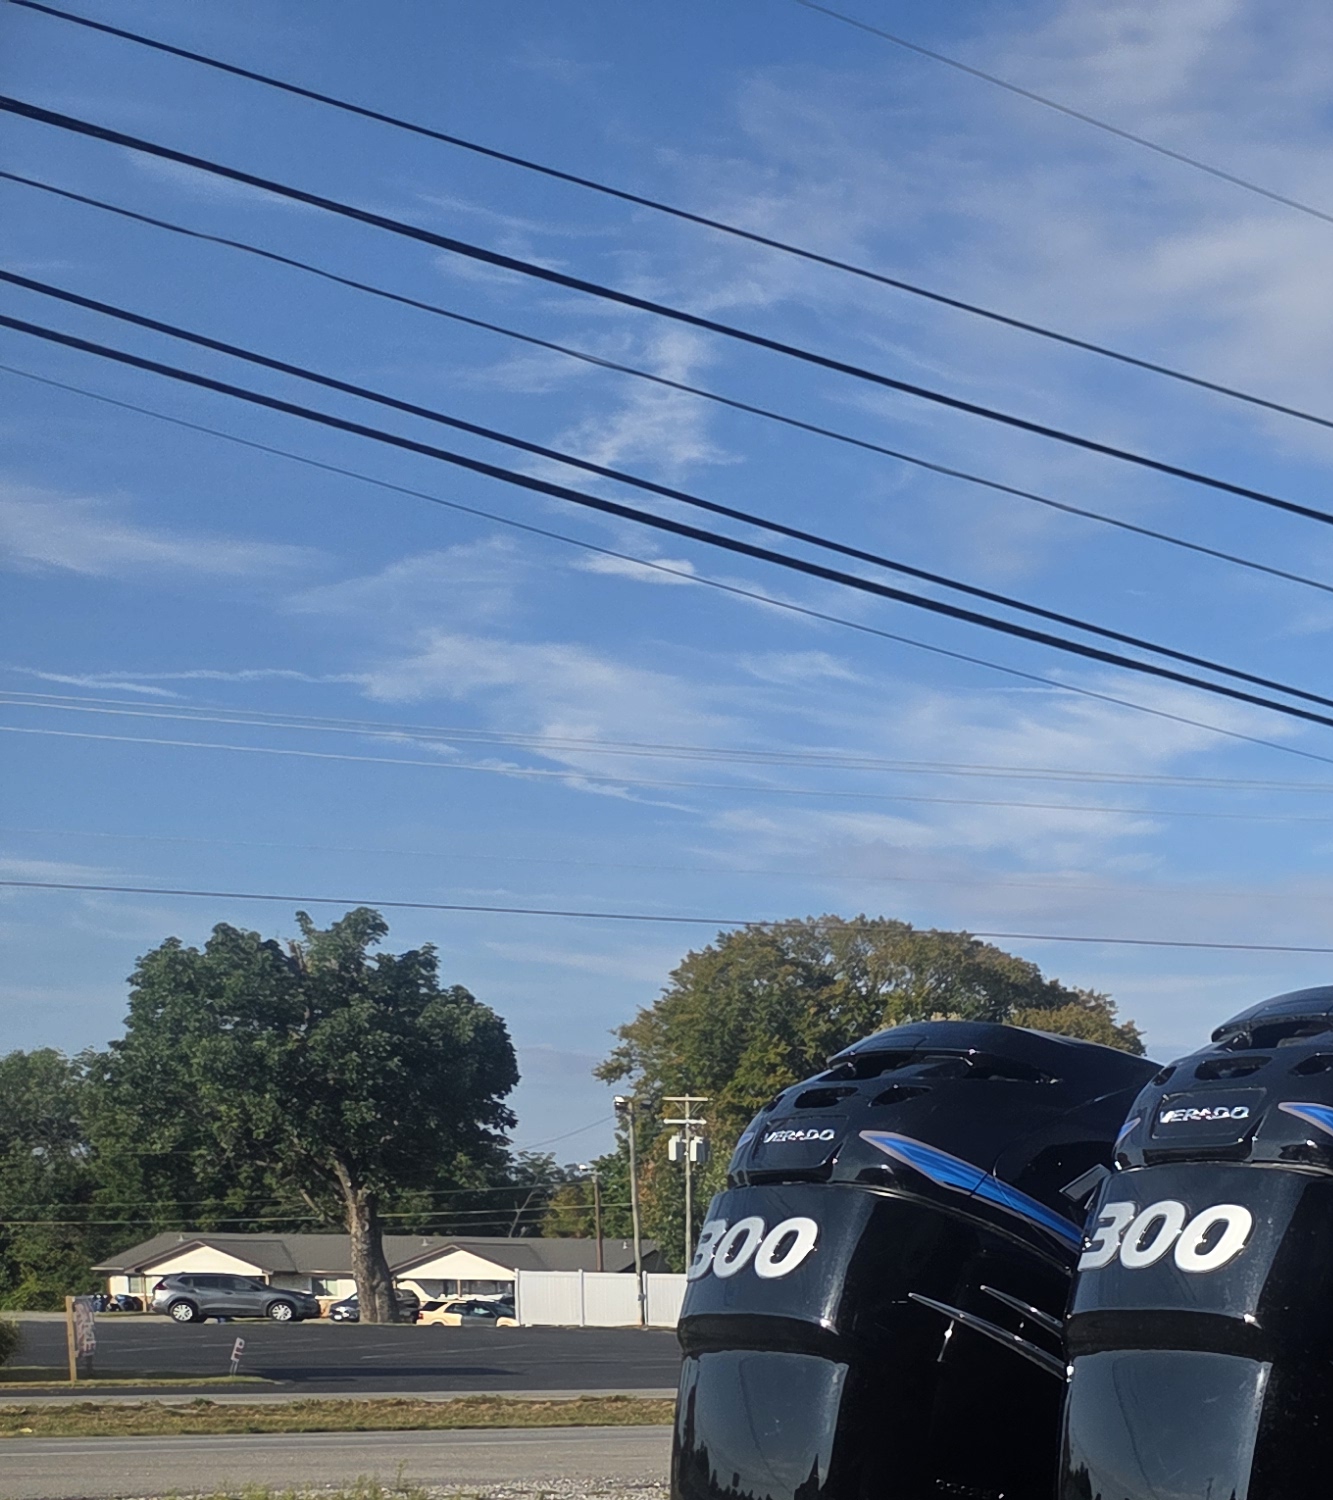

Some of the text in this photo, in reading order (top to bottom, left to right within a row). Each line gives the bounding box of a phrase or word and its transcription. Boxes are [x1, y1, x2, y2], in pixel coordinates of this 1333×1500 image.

[1160, 1106, 1250, 1124] VERADO
[763, 1128, 835, 1144] VERADO
[687, 1216, 818, 1280] 300
[1077, 1200, 1253, 1273] 300
